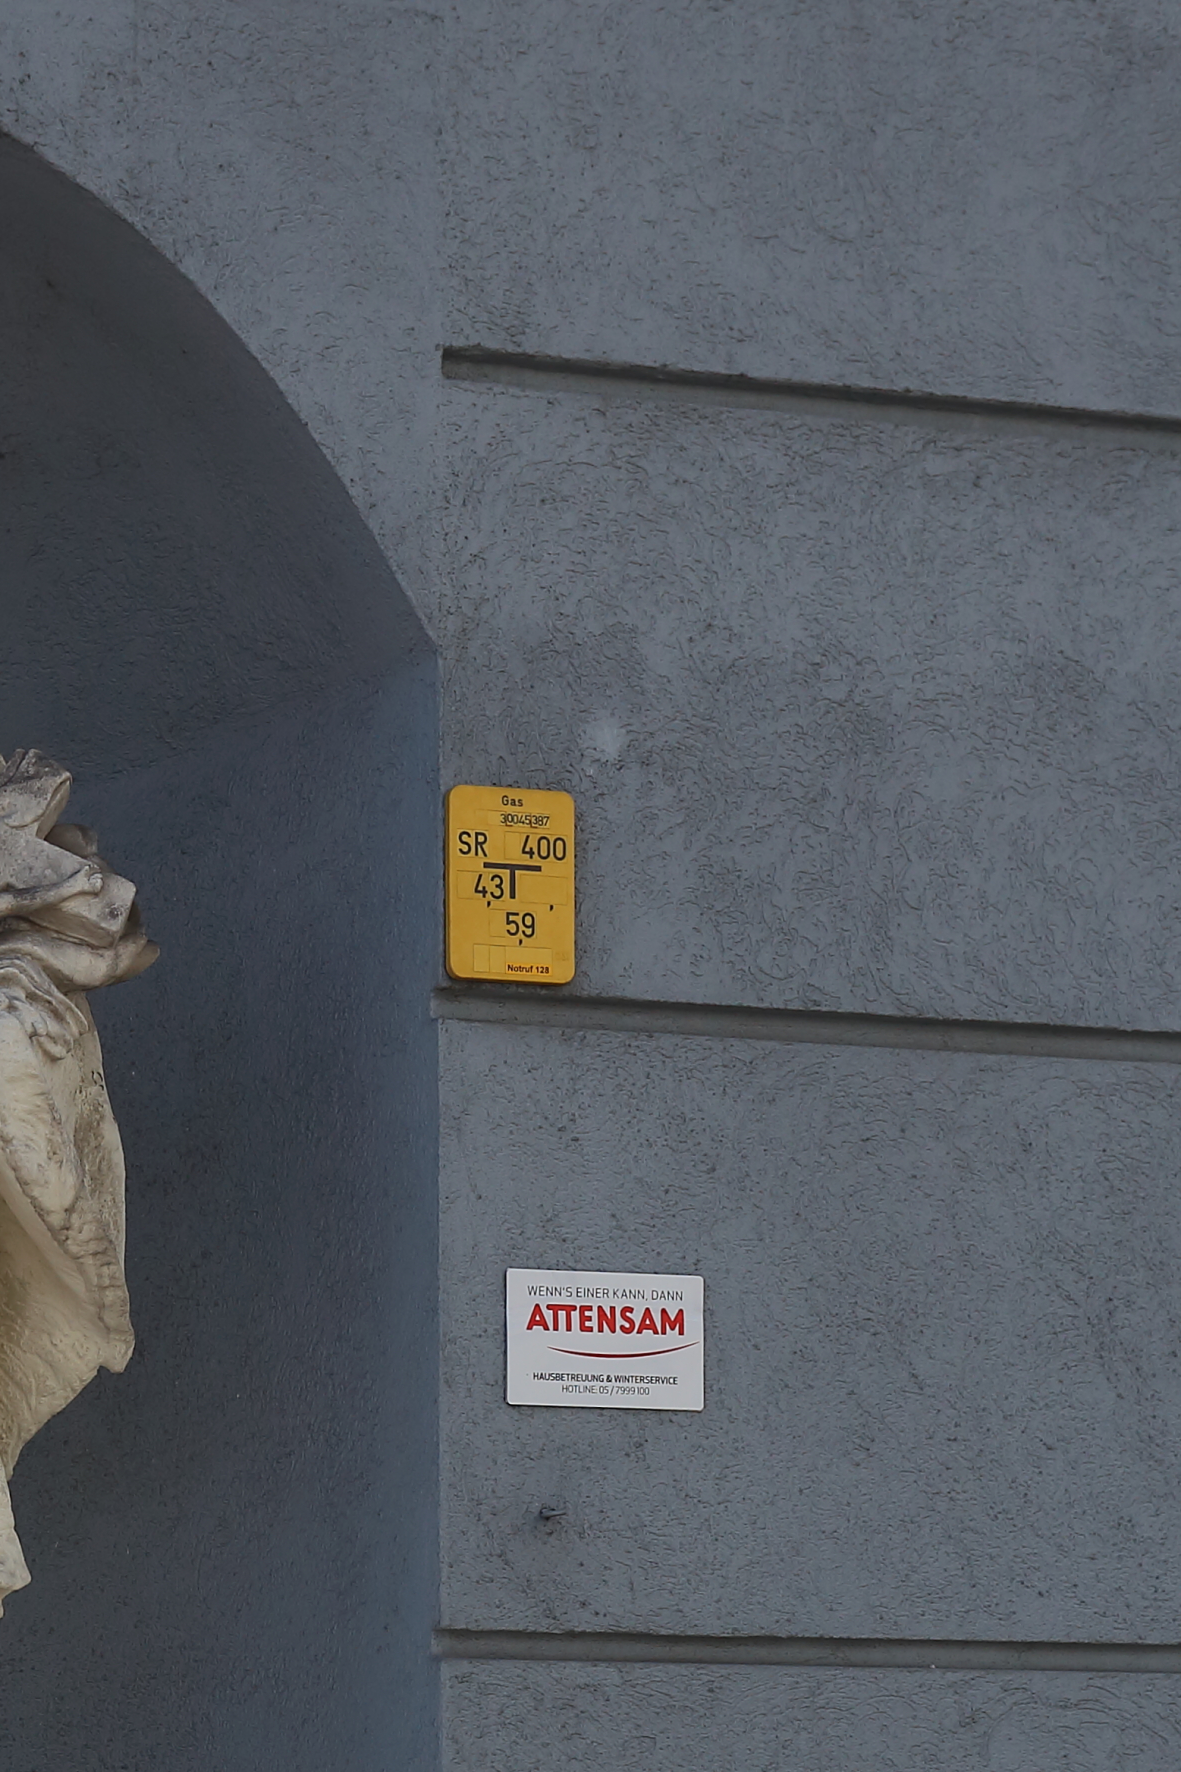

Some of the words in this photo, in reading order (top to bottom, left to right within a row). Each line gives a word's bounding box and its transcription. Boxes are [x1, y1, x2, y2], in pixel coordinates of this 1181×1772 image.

[501, 795, 523, 807] Gas
[500, 813, 550, 826] 30045387
[458, 831, 488, 857] SR
[521, 835, 567, 861] 400
[507, 964, 533, 973] Notruf
[535, 966, 550, 974] 128
[527, 1285, 573, 1298] WENN'S
[576, 1287, 610, 1299] EINER
[612, 1288, 648, 1301] KANN,
[651, 1290, 683, 1301] DANN
[526, 1303, 685, 1336] ATTENSAM
[533, 1372, 604, 1383] HAUSBETREUUNG
[606, 1375, 612, 1383] &
[614, 1375, 678, 1385] WINTERSERVICE
